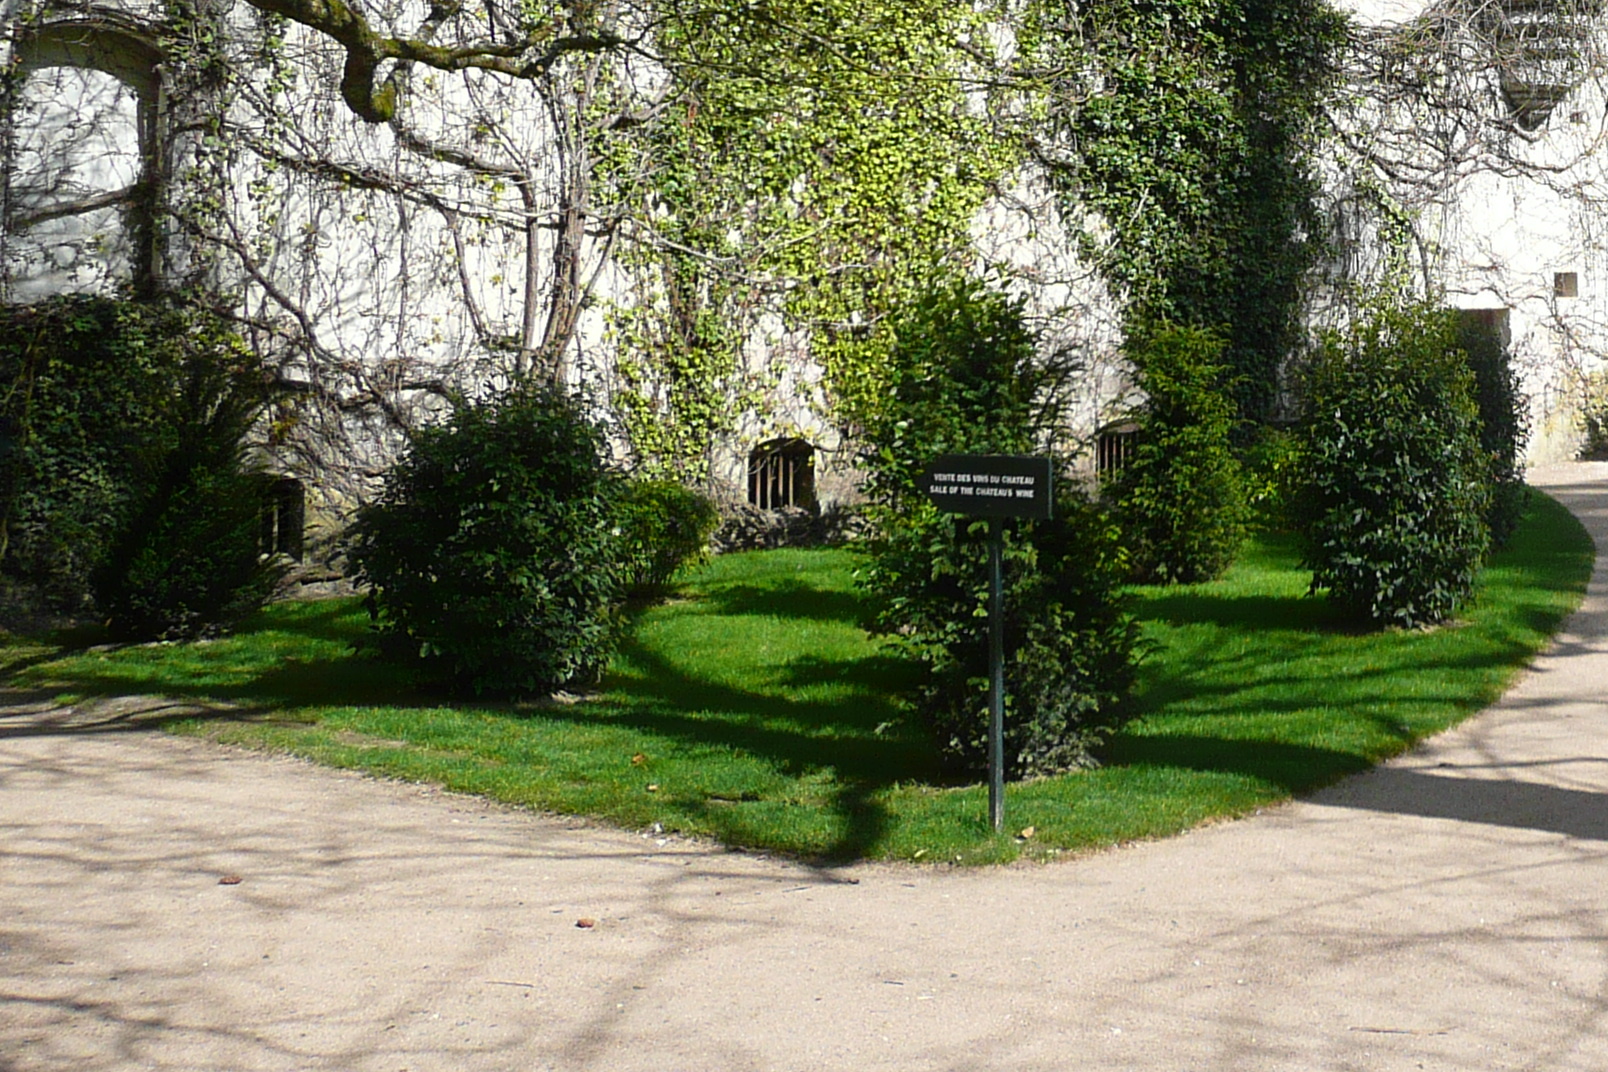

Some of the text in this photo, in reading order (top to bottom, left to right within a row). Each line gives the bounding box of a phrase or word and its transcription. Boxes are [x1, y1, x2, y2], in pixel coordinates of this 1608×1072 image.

[933, 473, 956, 482] VENTE
[957, 474, 971, 483] DES
[973, 474, 989, 483] VINS
[990, 475, 1000, 484] DU
[930, 485, 947, 494] SALE
[949, 486, 959, 494] OF
[960, 486, 974, 495] THE
[1016, 489, 1035, 498] WINE
